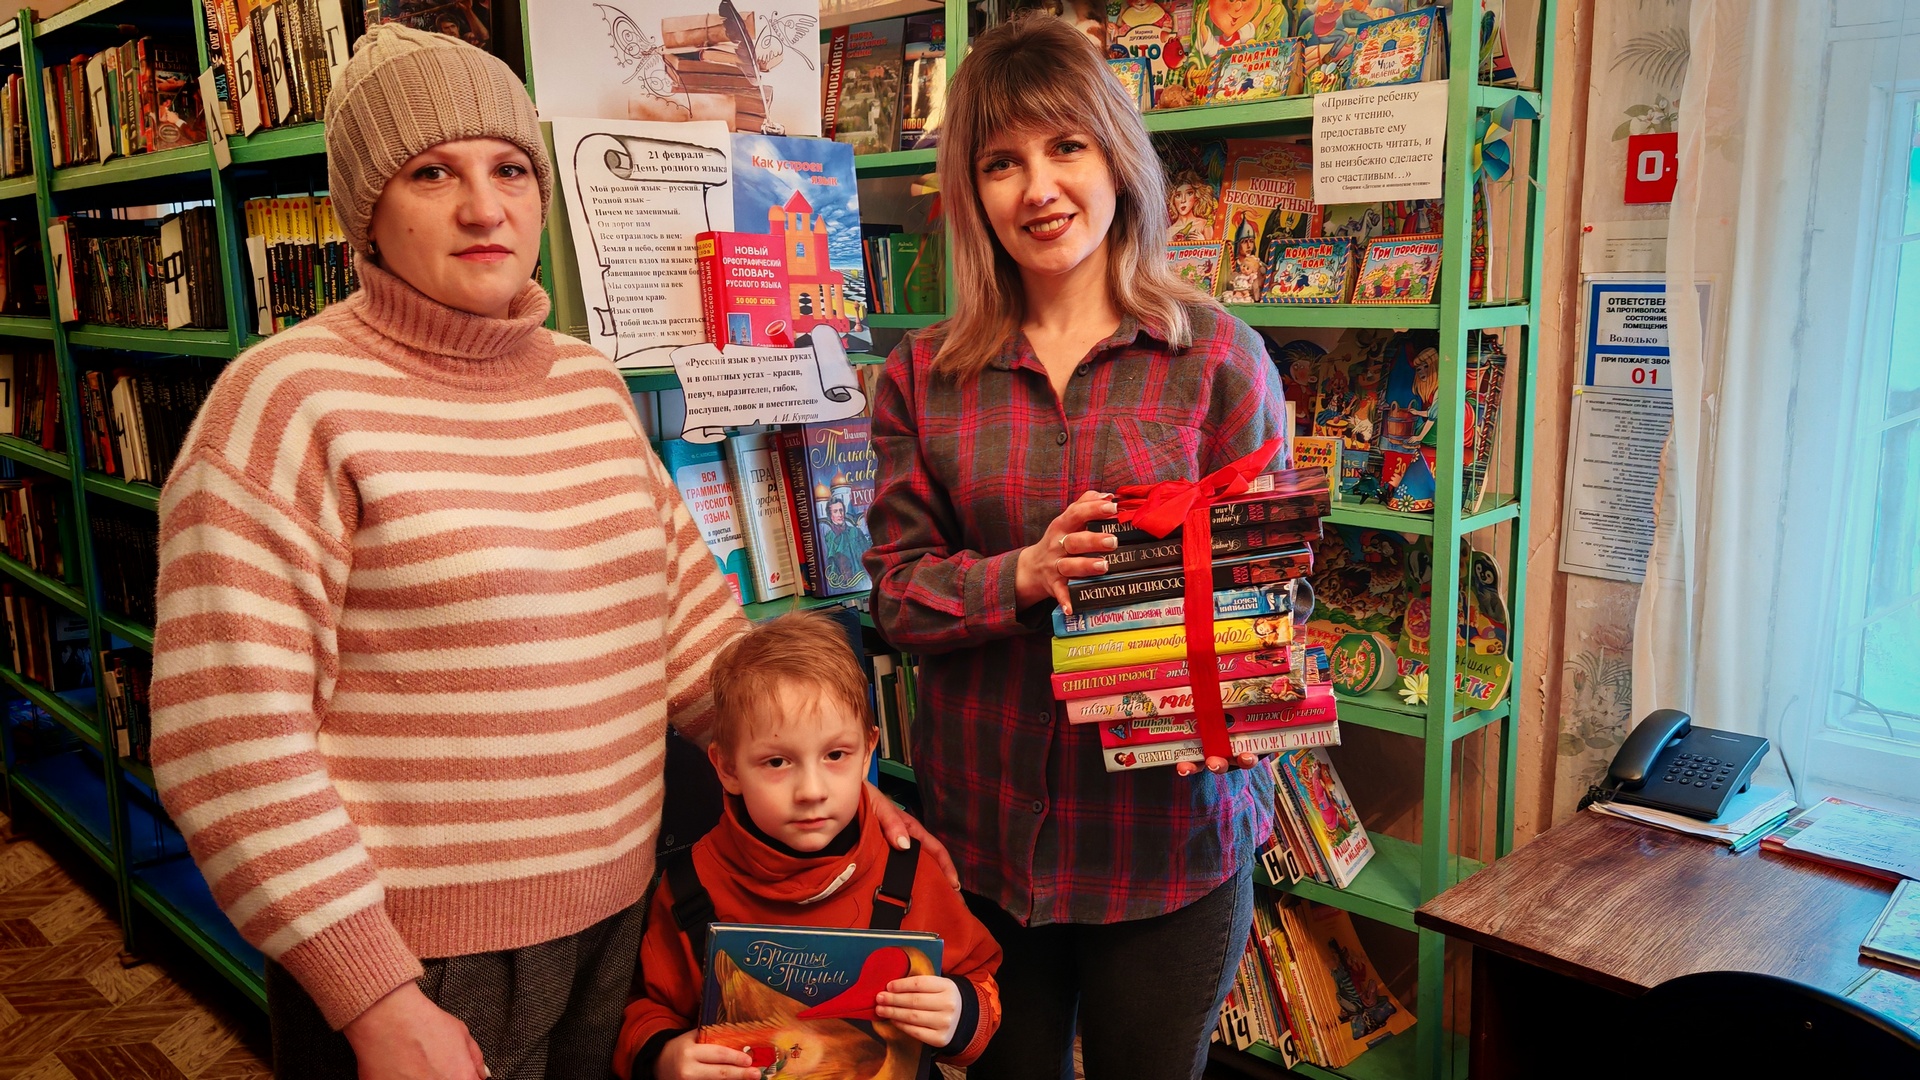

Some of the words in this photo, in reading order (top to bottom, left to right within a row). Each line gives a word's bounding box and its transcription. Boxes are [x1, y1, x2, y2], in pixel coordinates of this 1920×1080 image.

[325, 25, 340, 68] Г
[1129, 44, 1161, 59] ЧТО
[268, 38, 283, 87] В
[1230, 47, 1279, 64] КОЗЛЯТКИ
[1247, 60, 1271, 73] ВОЛК
[235, 50, 253, 100] Б
[1321, 95, 1375, 109] «Привейте
[1377, 90, 1420, 106] ребенку
[210, 102, 224, 146] А
[1321, 114, 1343, 125] вкус
[1354, 109, 1394, 120] чтению,
[1320, 125, 1385, 140] предоставьте
[1387, 124, 1407, 134] ему
[1320, 141, 1383, 154] возможность
[1386, 138, 1422, 149] читать,
[1425, 137, 1432, 145] и
[648, 151, 659, 160] 21
[662, 150, 704, 162] февраля
[752, 156, 774, 168] Как
[1320, 160, 1333, 169] вы
[1335, 156, 1387, 168] неизбежно
[1389, 153, 1433, 164] сделаете
[633, 164, 659, 173] День
[661, 164, 700, 174] родного
[702, 165, 727, 173] языка
[810, 175, 838, 186] язык
[1250, 178, 1296, 195] КОЩЕЙ
[1320, 175, 1334, 184] его
[590, 185, 608, 193] Мой
[610, 185, 640, 194] родной
[668, 185, 701, 193] русский.
[592, 197, 622, 205] Родной
[595, 209, 623, 217] Ничем
[734, 246, 769, 256] НОВЫЙ
[1285, 244, 1333, 258] КОЗЛЯТКИ
[1372, 245, 1391, 260] ТРИ
[722, 257, 782, 268] ОРФОГРАФИЧЕСКИЙ
[1301, 258, 1326, 269] ВОЛК
[163, 250, 185, 295] Ф
[731, 267, 775, 279] СЛОВАРЬ
[725, 279, 760, 289] РУССКОГО
[760, 280, 782, 289] ЯЗЫКА
[610, 307, 631, 315] Язык
[1609, 333, 1658, 345] Володько
[685, 356, 726, 368] «Русский
[727, 355, 749, 365] язык
[757, 354, 788, 364] умелых
[789, 353, 812, 362] руках
[1618, 357, 1649, 365] ПОЖАРЕ
[702, 373, 741, 382] опытных
[743, 371, 765, 381] устах
[772, 369, 803, 379] красив,
[1631, 367, 1658, 385] 01
[687, 390, 715, 400] певуч,
[716, 387, 771, 397] выразителен,
[772, 384, 798, 394] гибок,
[688, 405, 732, 416] послушен,
[732, 402, 757, 411] ловок
[772, 414, 780, 423] А.
[781, 413, 791, 422] И.
[792, 412, 819, 423] Куприн
[701, 471, 717, 483] ВСЯ
[694, 495, 733, 513] РУССКОГО
[795, 489, 811, 528] СЛОВАРЬ
[703, 510, 731, 525] ЯЗЫКА
[712, 527, 732, 536] простых
[803, 531, 817, 579] ТОЛКОВЫЙ
[1079, 585, 1126, 601] КВАДРАТ
[1219, 602, 1258, 613] ПАТРИЦИЯ
[1233, 597, 1258, 605] КЭБОТ
[1067, 645, 1095, 657] КАУИ
[1098, 639, 1125, 653] Вера
[1118, 668, 1159, 682] Джеки
[1062, 675, 1117, 692] КОЛЛИНЗ
[1081, 701, 1115, 717] Кауи
[1117, 701, 1155, 718] Вера
[1246, 707, 1295, 722] Джеллис
[1296, 707, 1326, 717] РОБЕРТА
[1132, 717, 1176, 729] мечта
[1292, 729, 1333, 747] АЙРИС
[1138, 750, 1172, 763] ВИХРЬ
[1265, 850, 1283, 881] Н
[743, 940, 834, 970] Братья
[767, 961, 849, 991] Гримм
[1237, 1015, 1251, 1044] Ч
[1284, 1034, 1299, 1067] Я
